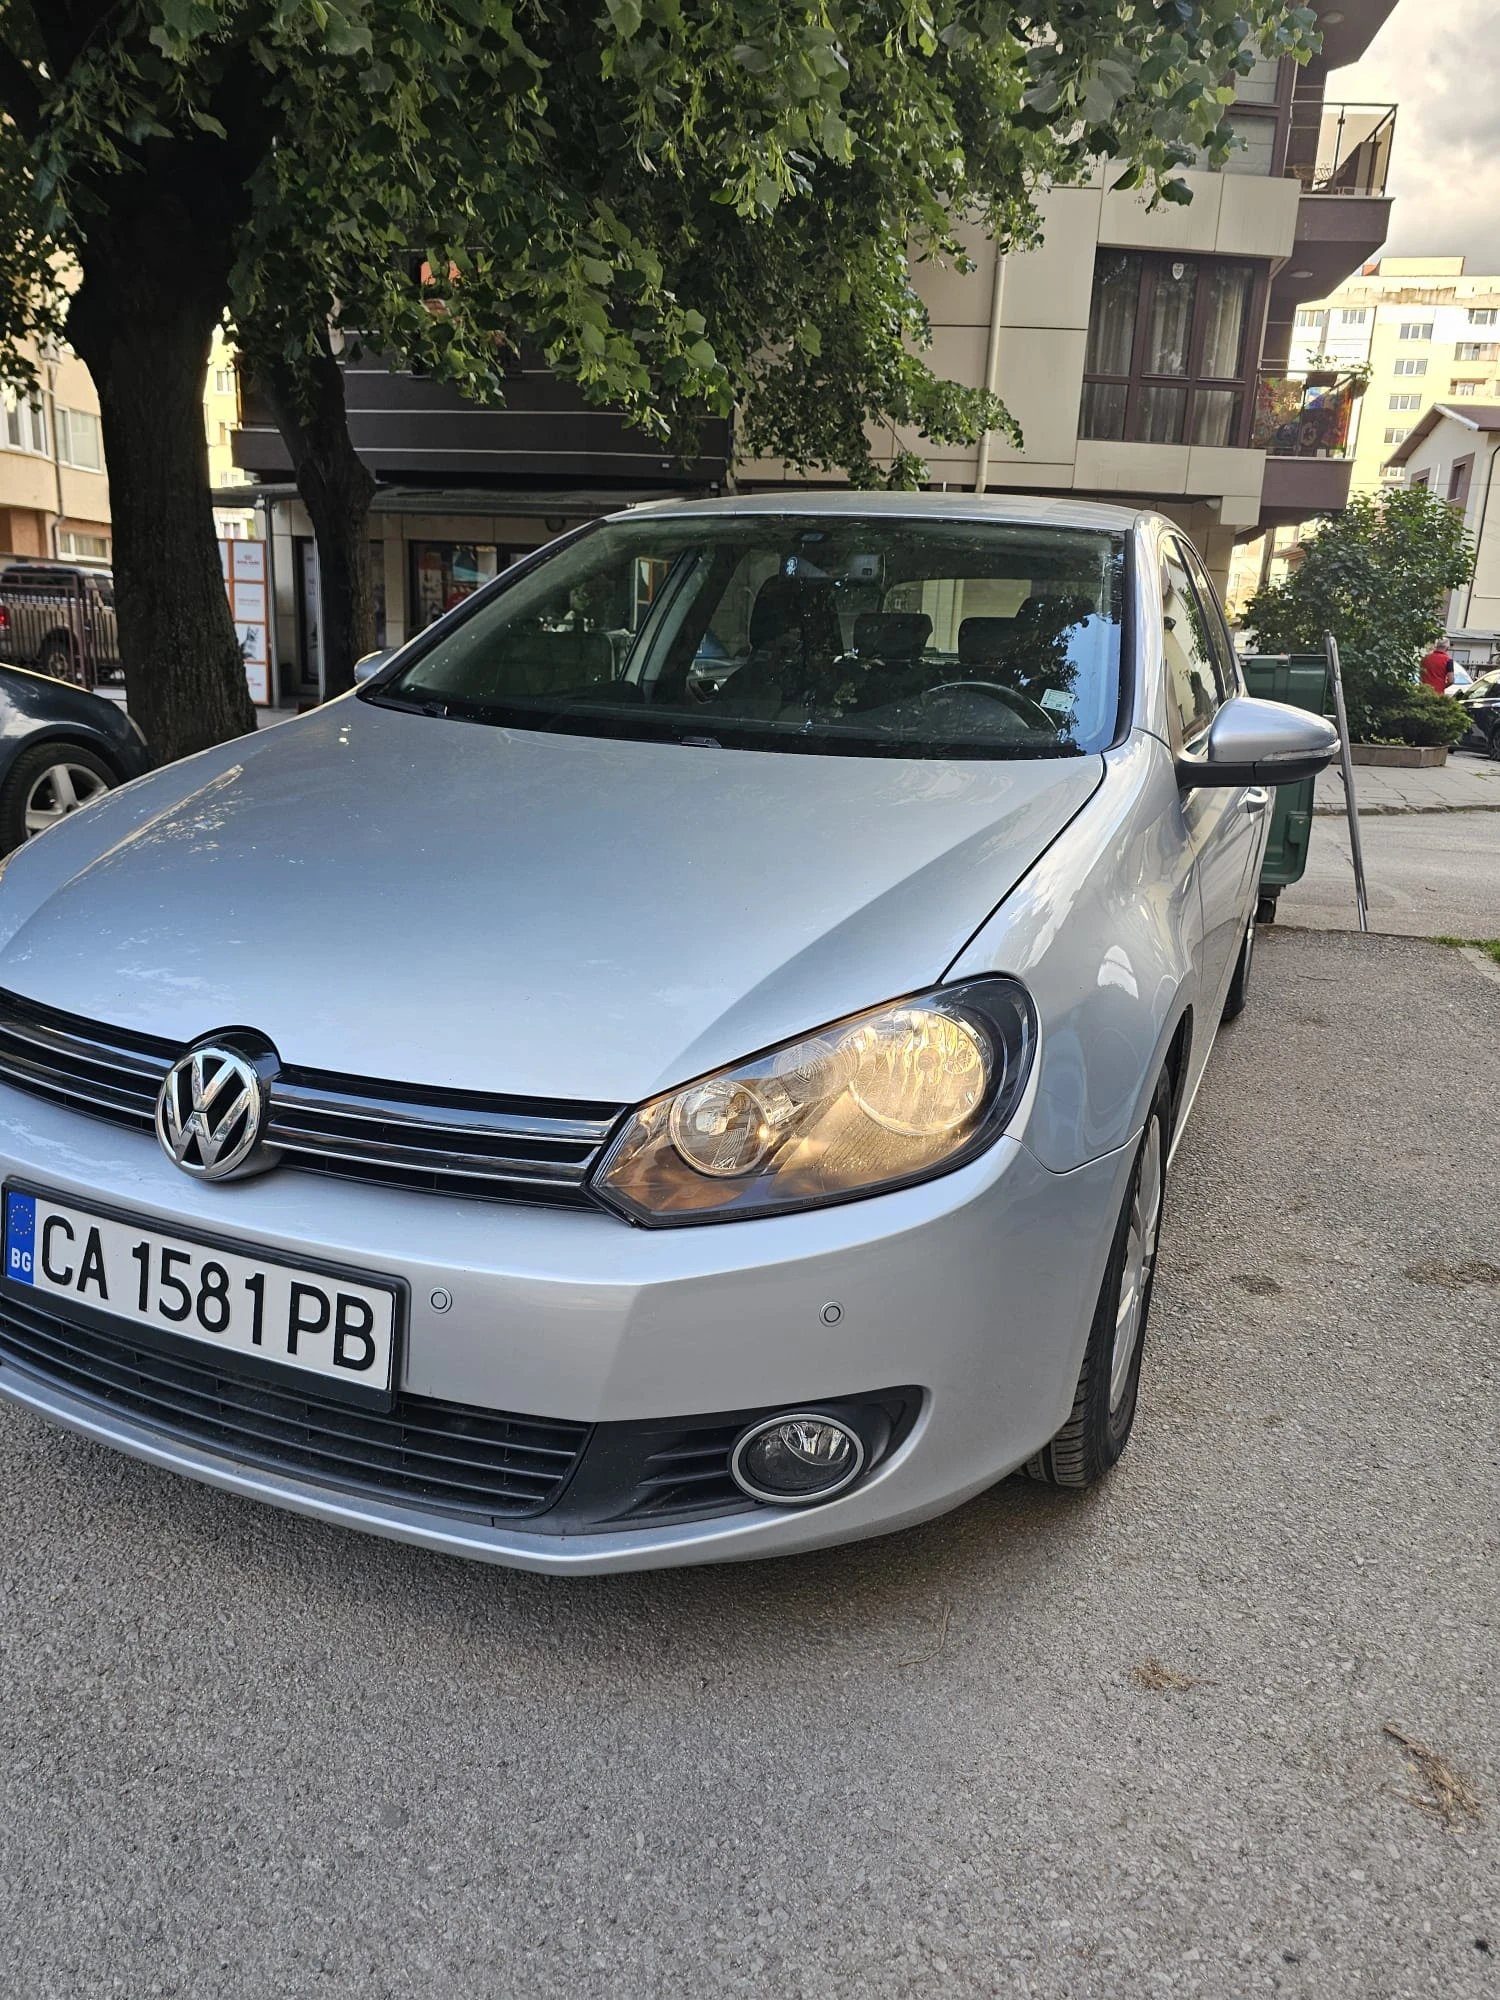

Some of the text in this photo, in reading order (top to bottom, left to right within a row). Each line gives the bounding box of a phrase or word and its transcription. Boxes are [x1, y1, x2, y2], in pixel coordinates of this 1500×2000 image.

[158, 1048, 258, 1176] VW
[11, 1247, 32, 1273] BG
[41, 1214, 376, 1371] CA 1581 PB
